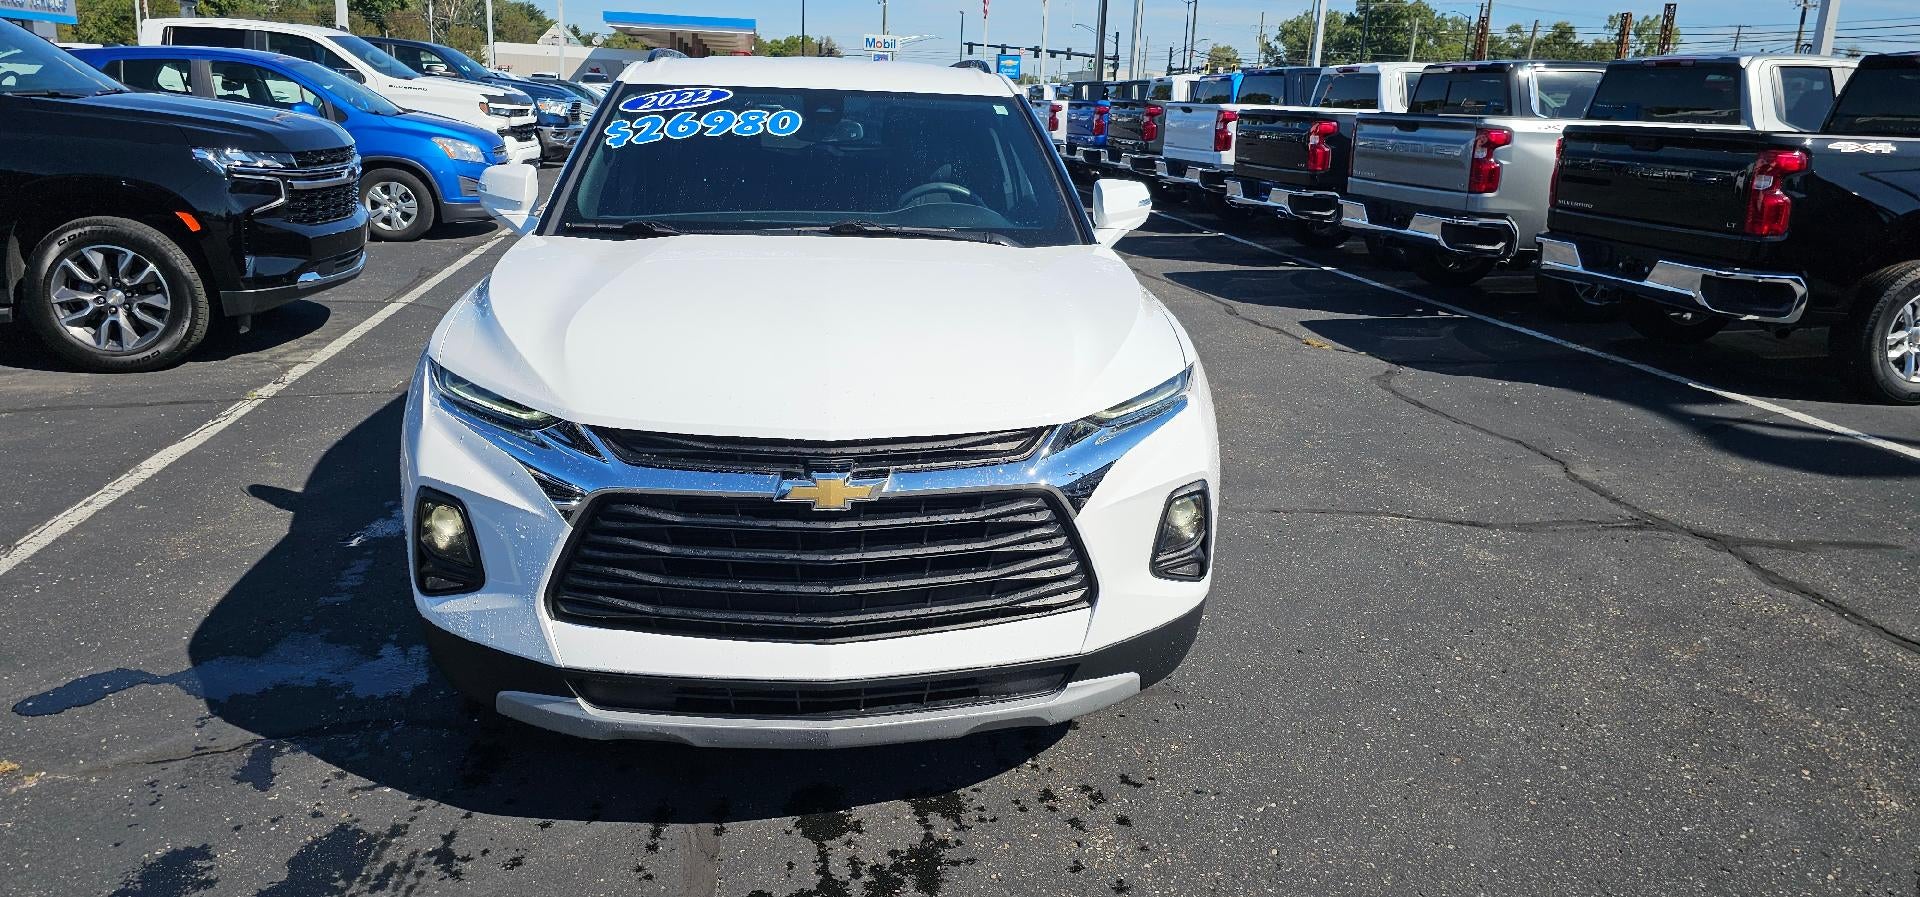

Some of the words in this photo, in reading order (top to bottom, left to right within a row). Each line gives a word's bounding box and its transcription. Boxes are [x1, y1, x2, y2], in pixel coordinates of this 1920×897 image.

[865, 37, 896, 49] Mobil
[637, 90, 712, 110] 2022
[604, 110, 803, 148] $26980
